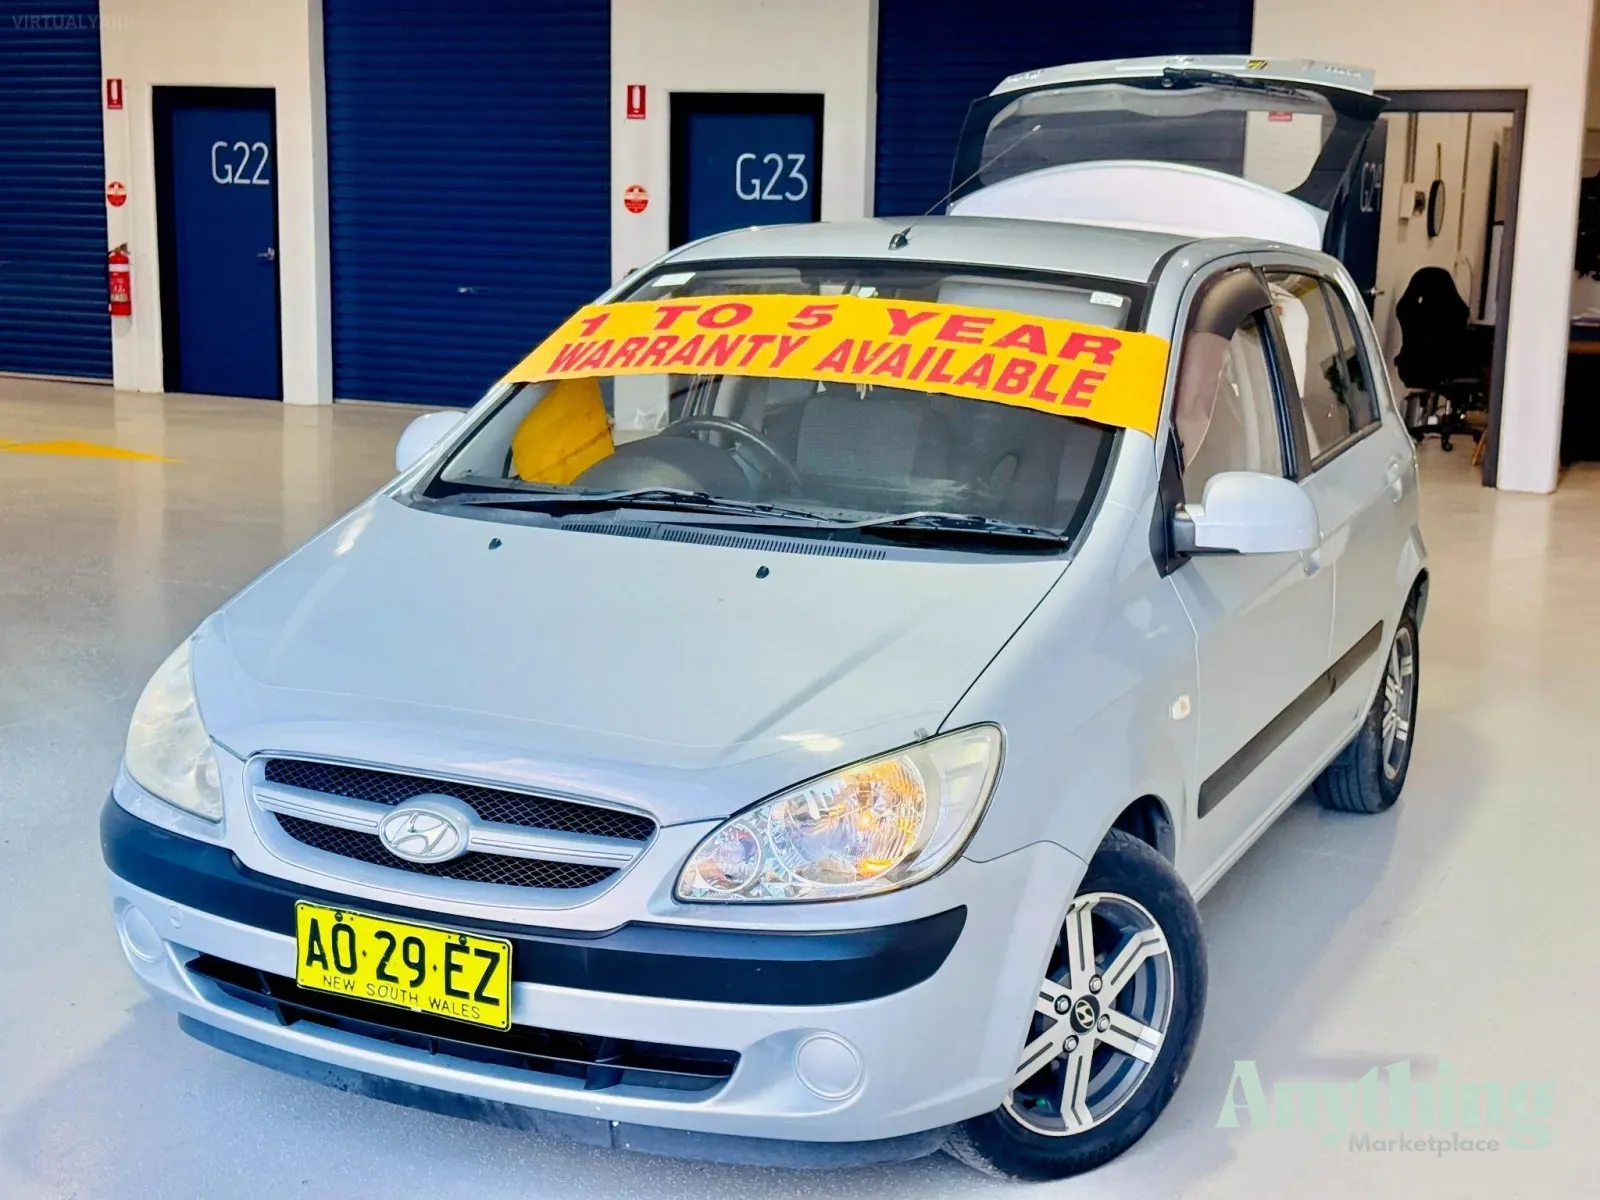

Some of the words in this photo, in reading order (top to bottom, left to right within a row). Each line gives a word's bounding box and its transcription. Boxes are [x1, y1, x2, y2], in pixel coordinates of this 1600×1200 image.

[211, 140, 271, 186] G22
[735, 152, 809, 202] G23
[580, 313, 609, 336] 1
[656, 303, 752, 330] TO
[787, 303, 839, 330] 5
[890, 309, 1120, 366] YEAR
[547, 335, 806, 374] WARRANTY
[815, 339, 1106, 407] AVAILABLE
[322, 974, 356, 993] NEW
[366, 983, 419, 1004] SOUTH
[428, 996, 482, 1020] WALES
